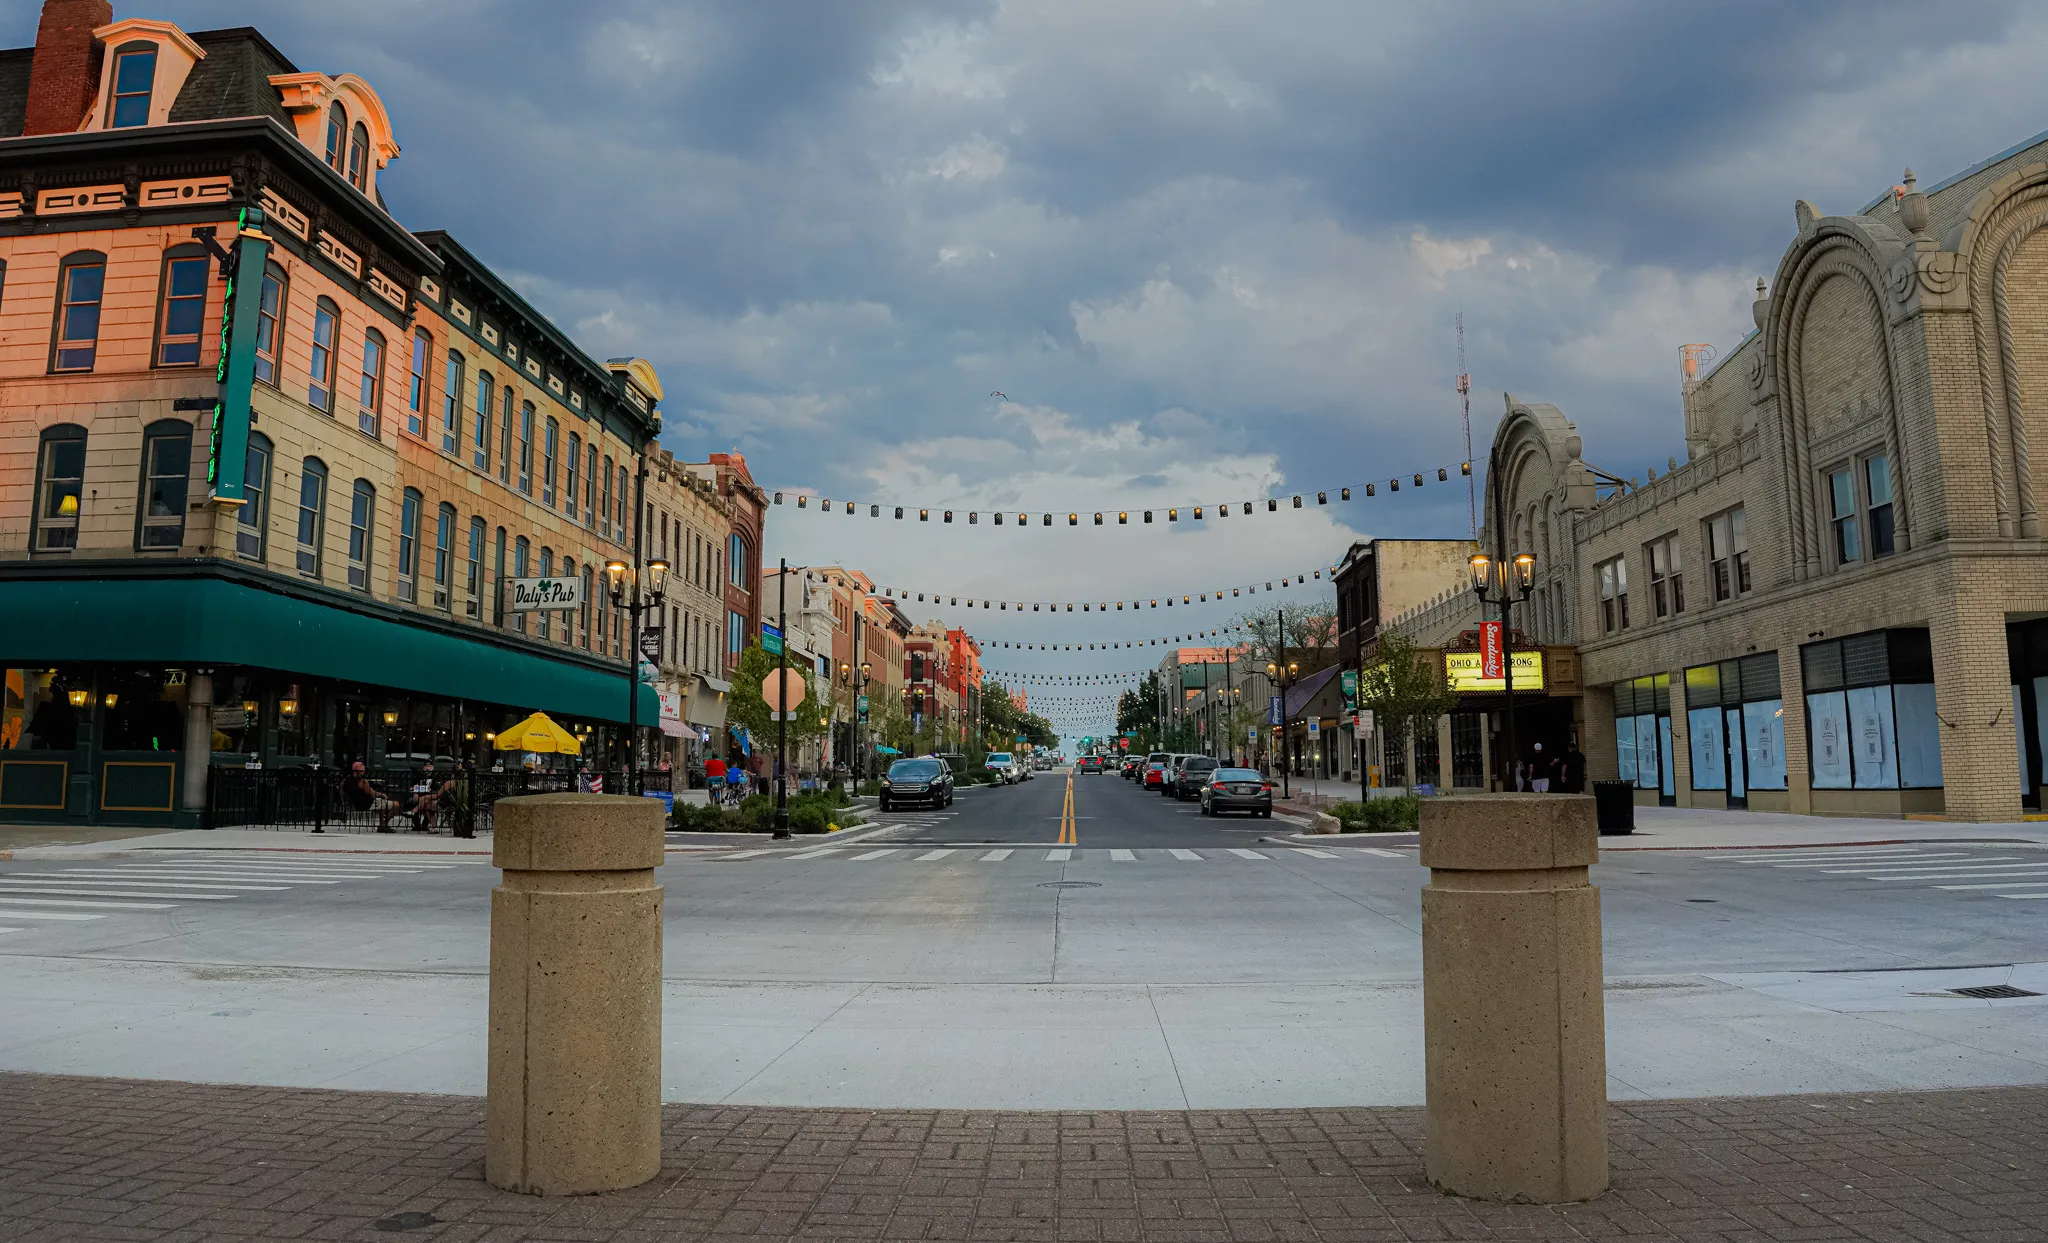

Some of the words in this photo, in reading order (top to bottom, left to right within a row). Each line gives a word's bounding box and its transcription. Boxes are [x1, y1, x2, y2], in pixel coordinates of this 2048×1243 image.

[551, 582, 575, 602] Pub
[1485, 623, 1500, 678] Sandusky
[1450, 659, 1471, 667] OHIO
